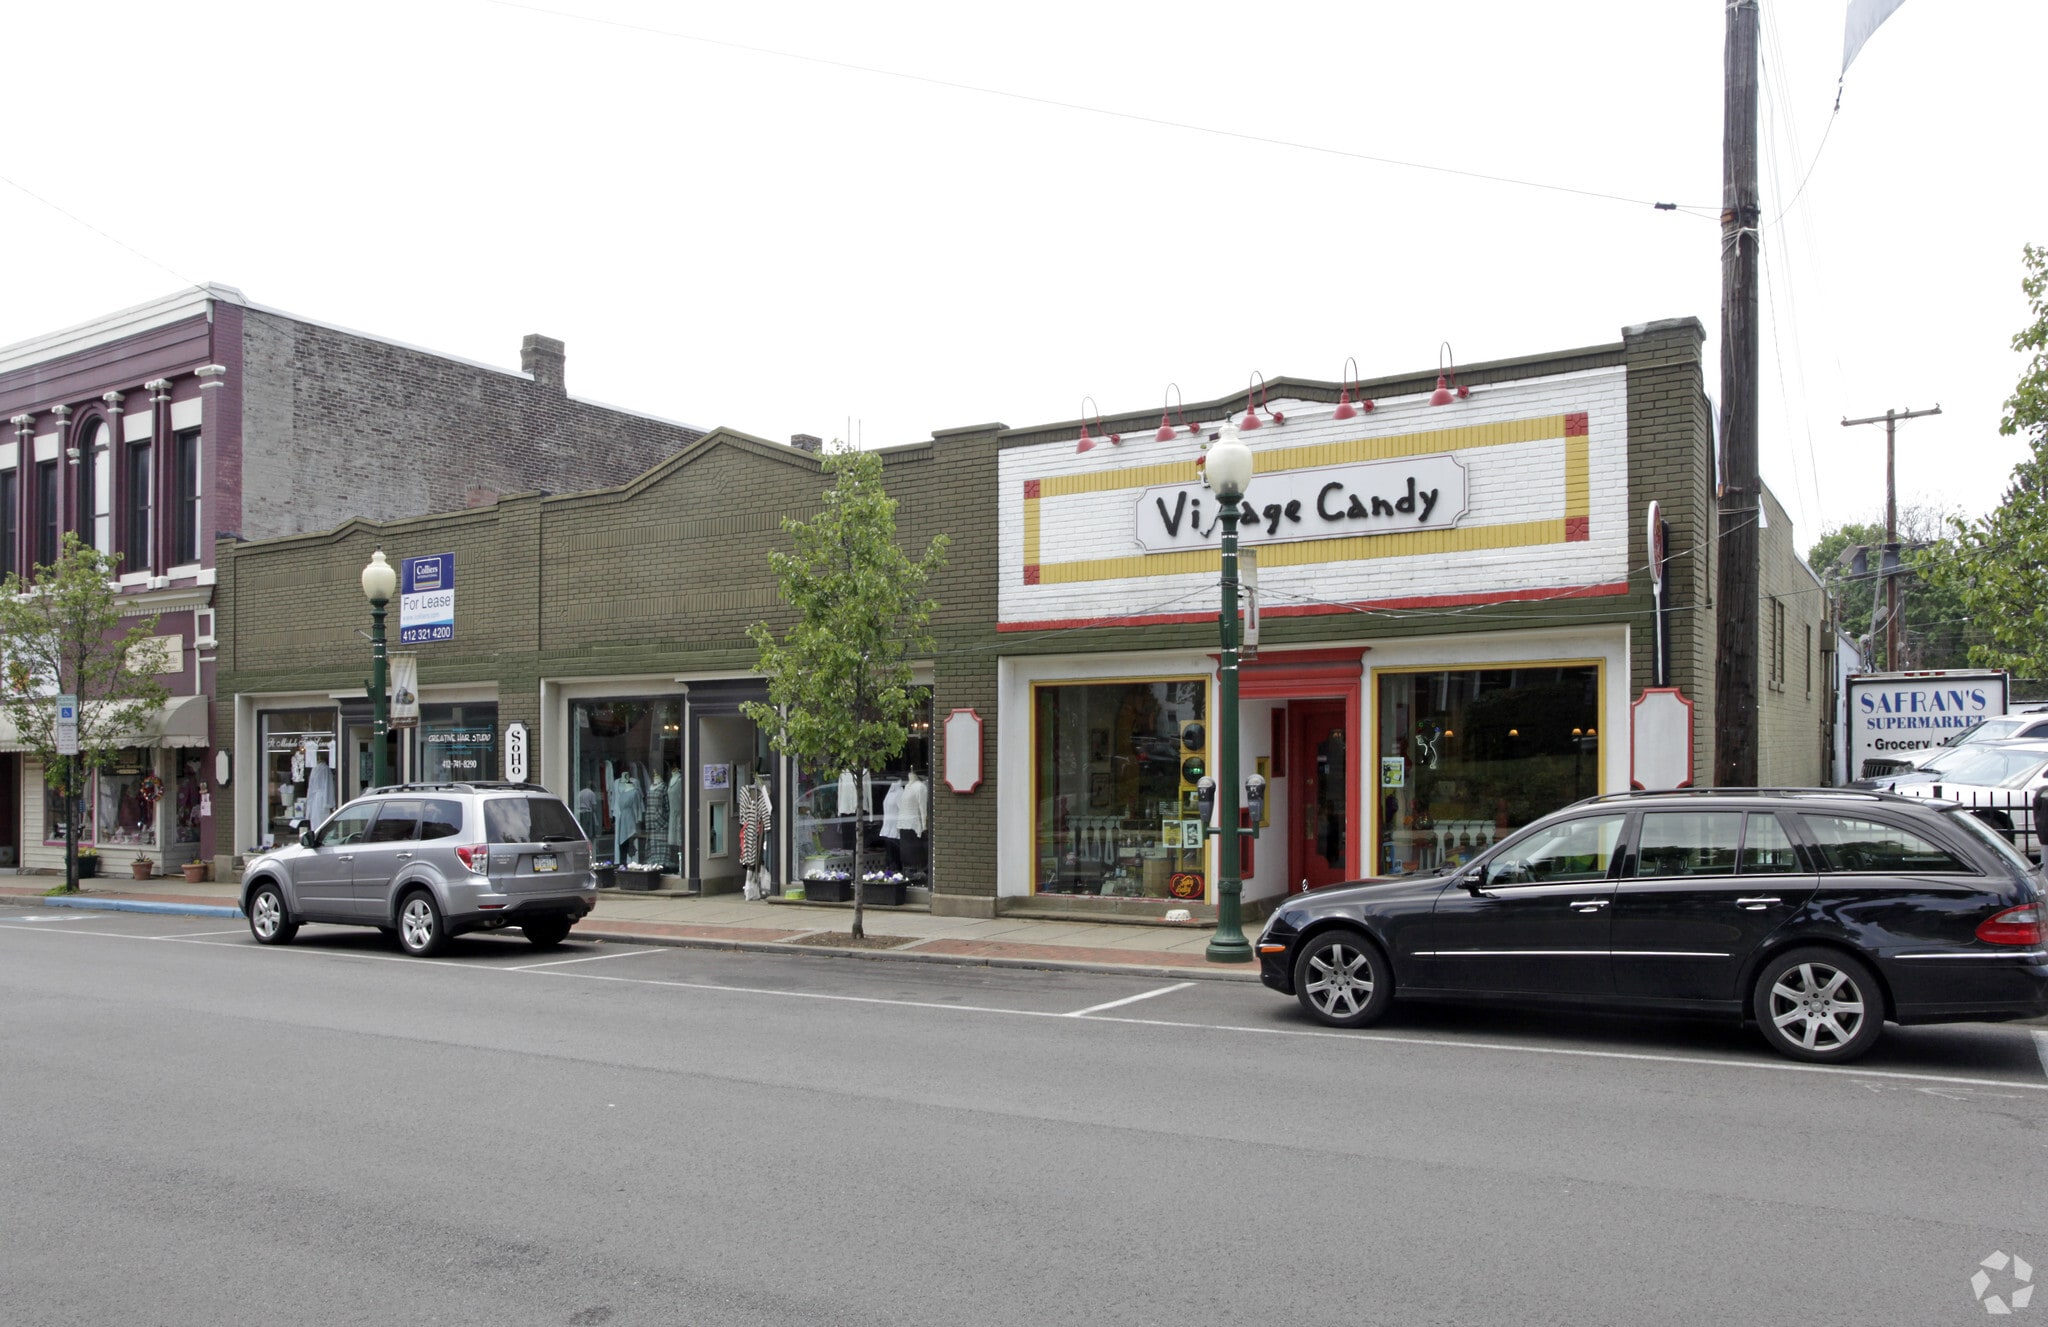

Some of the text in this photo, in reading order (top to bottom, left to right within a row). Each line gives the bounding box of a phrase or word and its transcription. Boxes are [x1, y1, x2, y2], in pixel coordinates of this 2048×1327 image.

[1156, 477, 1439, 537] Viage Candy
[416, 565, 438, 575] Colliers
[403, 595, 451, 611] For Lease
[403, 626, 451, 641] 412 321 4200
[1861, 688, 1987, 714] SAFRAN'S
[428, 733, 492, 743] CREATIVE HAIR STUDIO
